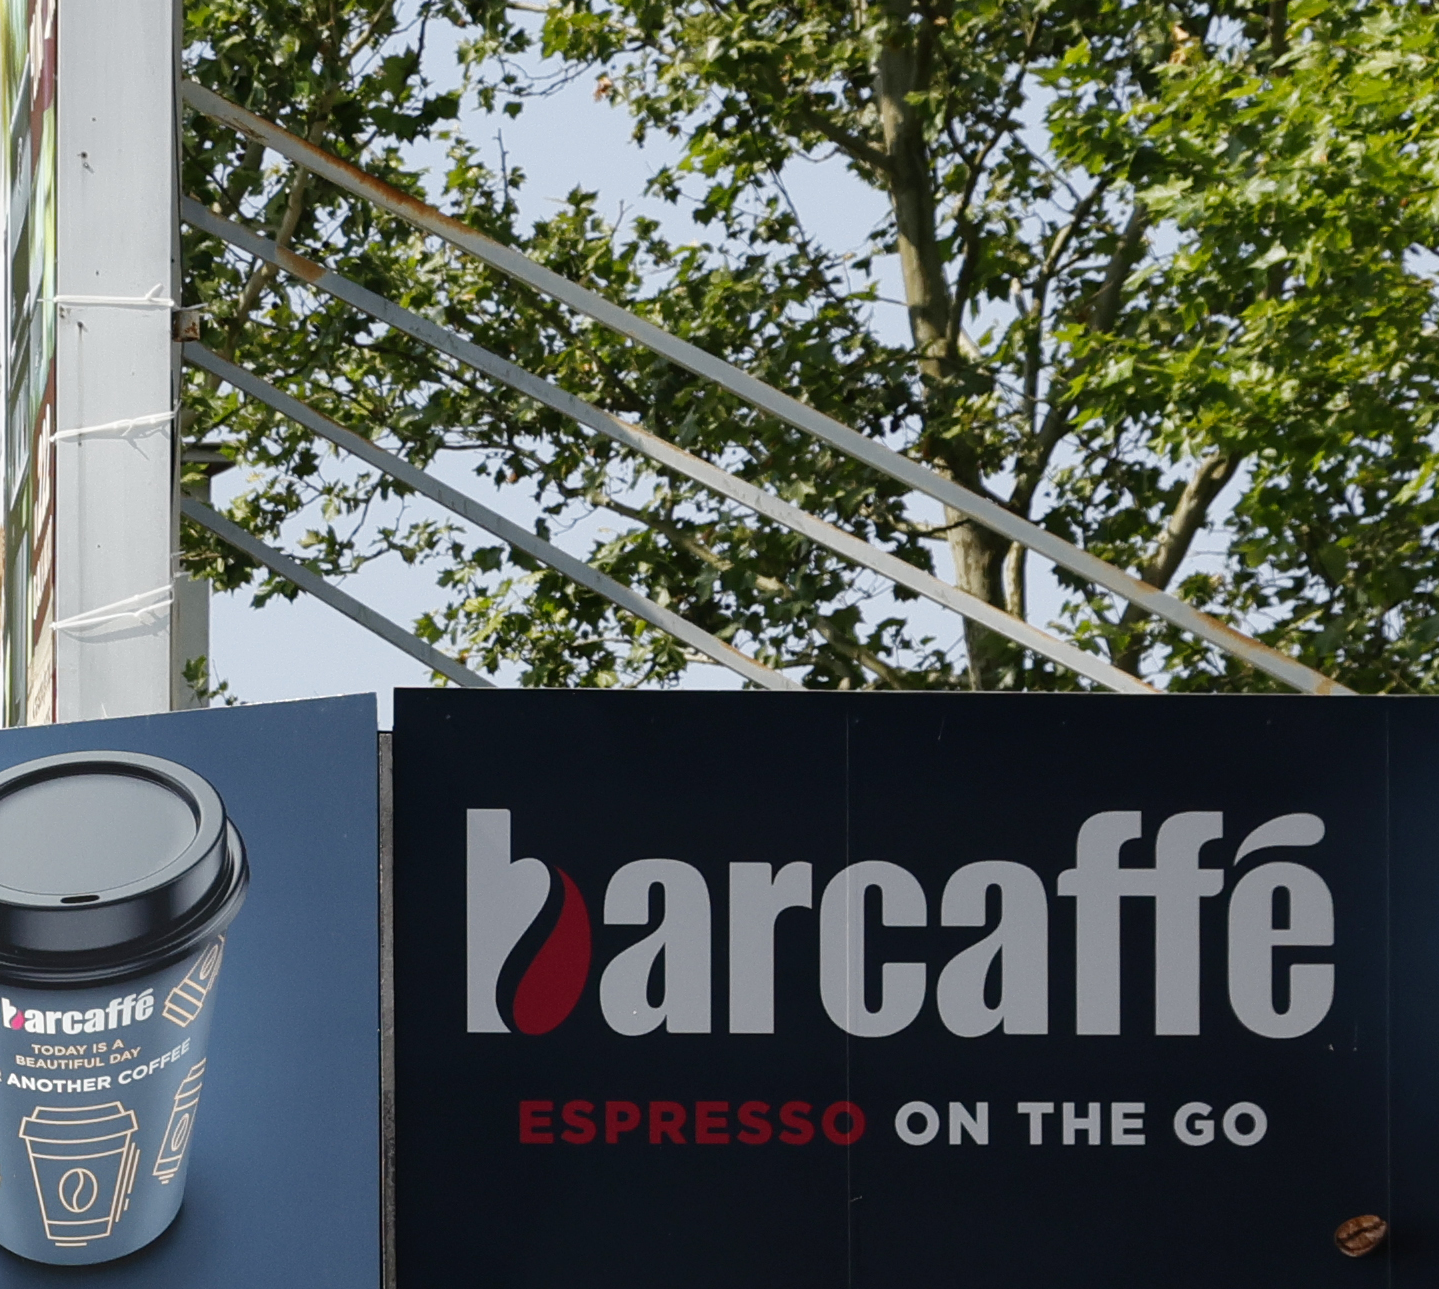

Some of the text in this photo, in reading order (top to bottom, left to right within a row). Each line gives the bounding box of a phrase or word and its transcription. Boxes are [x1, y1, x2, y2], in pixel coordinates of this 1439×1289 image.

[466, 808, 1336, 1038] barcaffé
[1, 988, 154, 1034] barcaffé
[6, 1073, 111, 1093] ANOTHER
[118, 1038, 191, 1089] COFFEE
[16, 1045, 141, 1070] BEAUTIFUL DAY
[31, 1040, 123, 1059] TODAY IS A
[519, 1099, 1268, 1147] ESPRESSO ON THE GO
